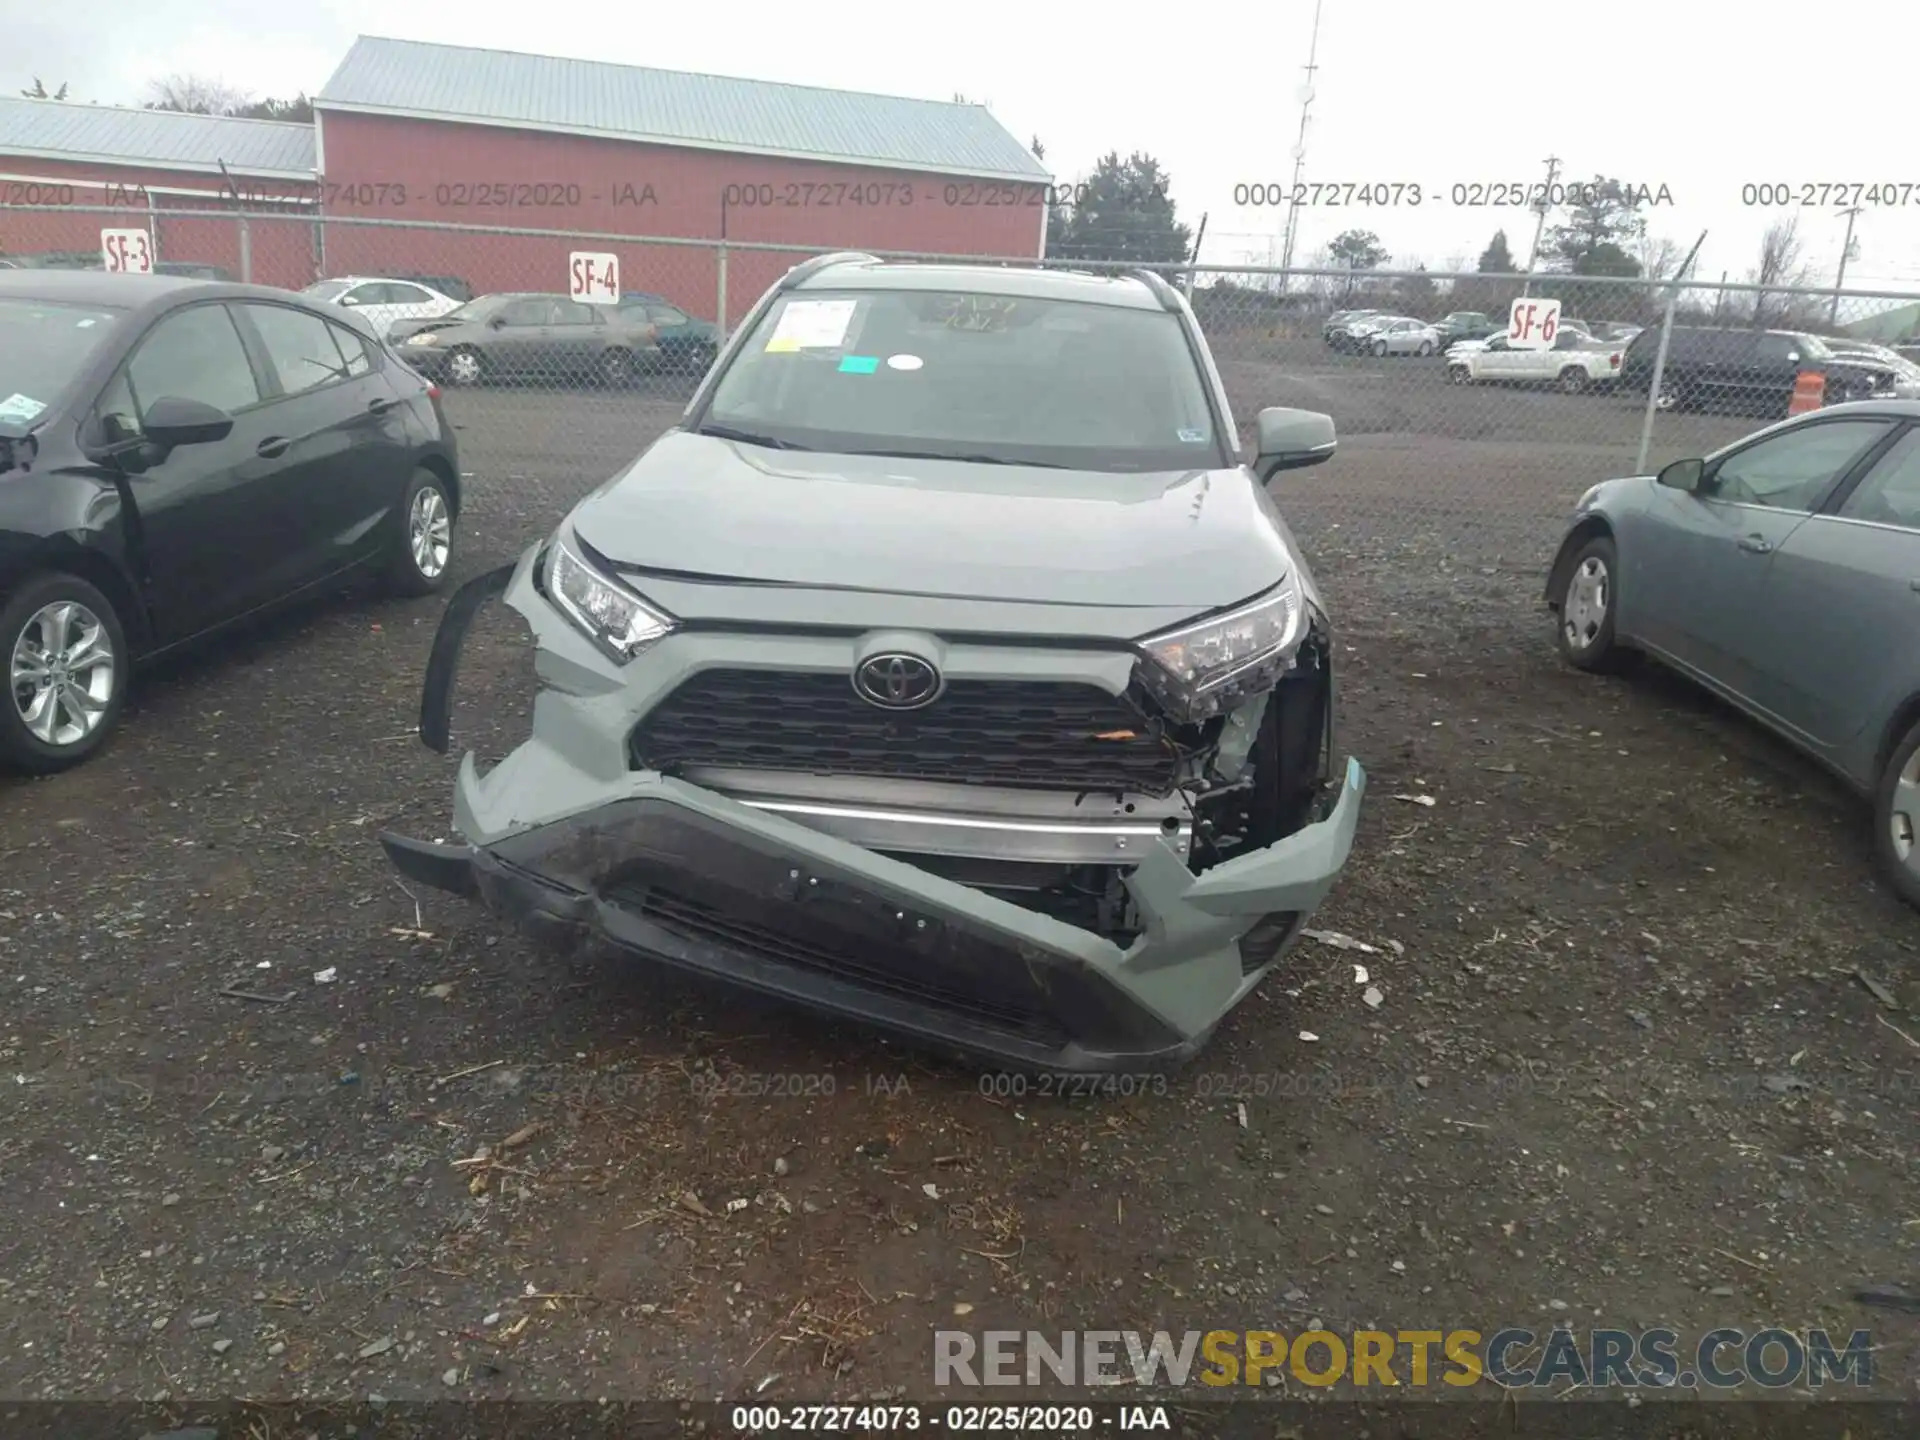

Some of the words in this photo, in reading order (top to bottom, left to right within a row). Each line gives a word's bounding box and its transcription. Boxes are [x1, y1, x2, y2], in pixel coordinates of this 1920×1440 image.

[106, 235, 149, 272] SF-3
[573, 258, 617, 297] SF-4
[1510, 304, 1557, 342] SF-6
